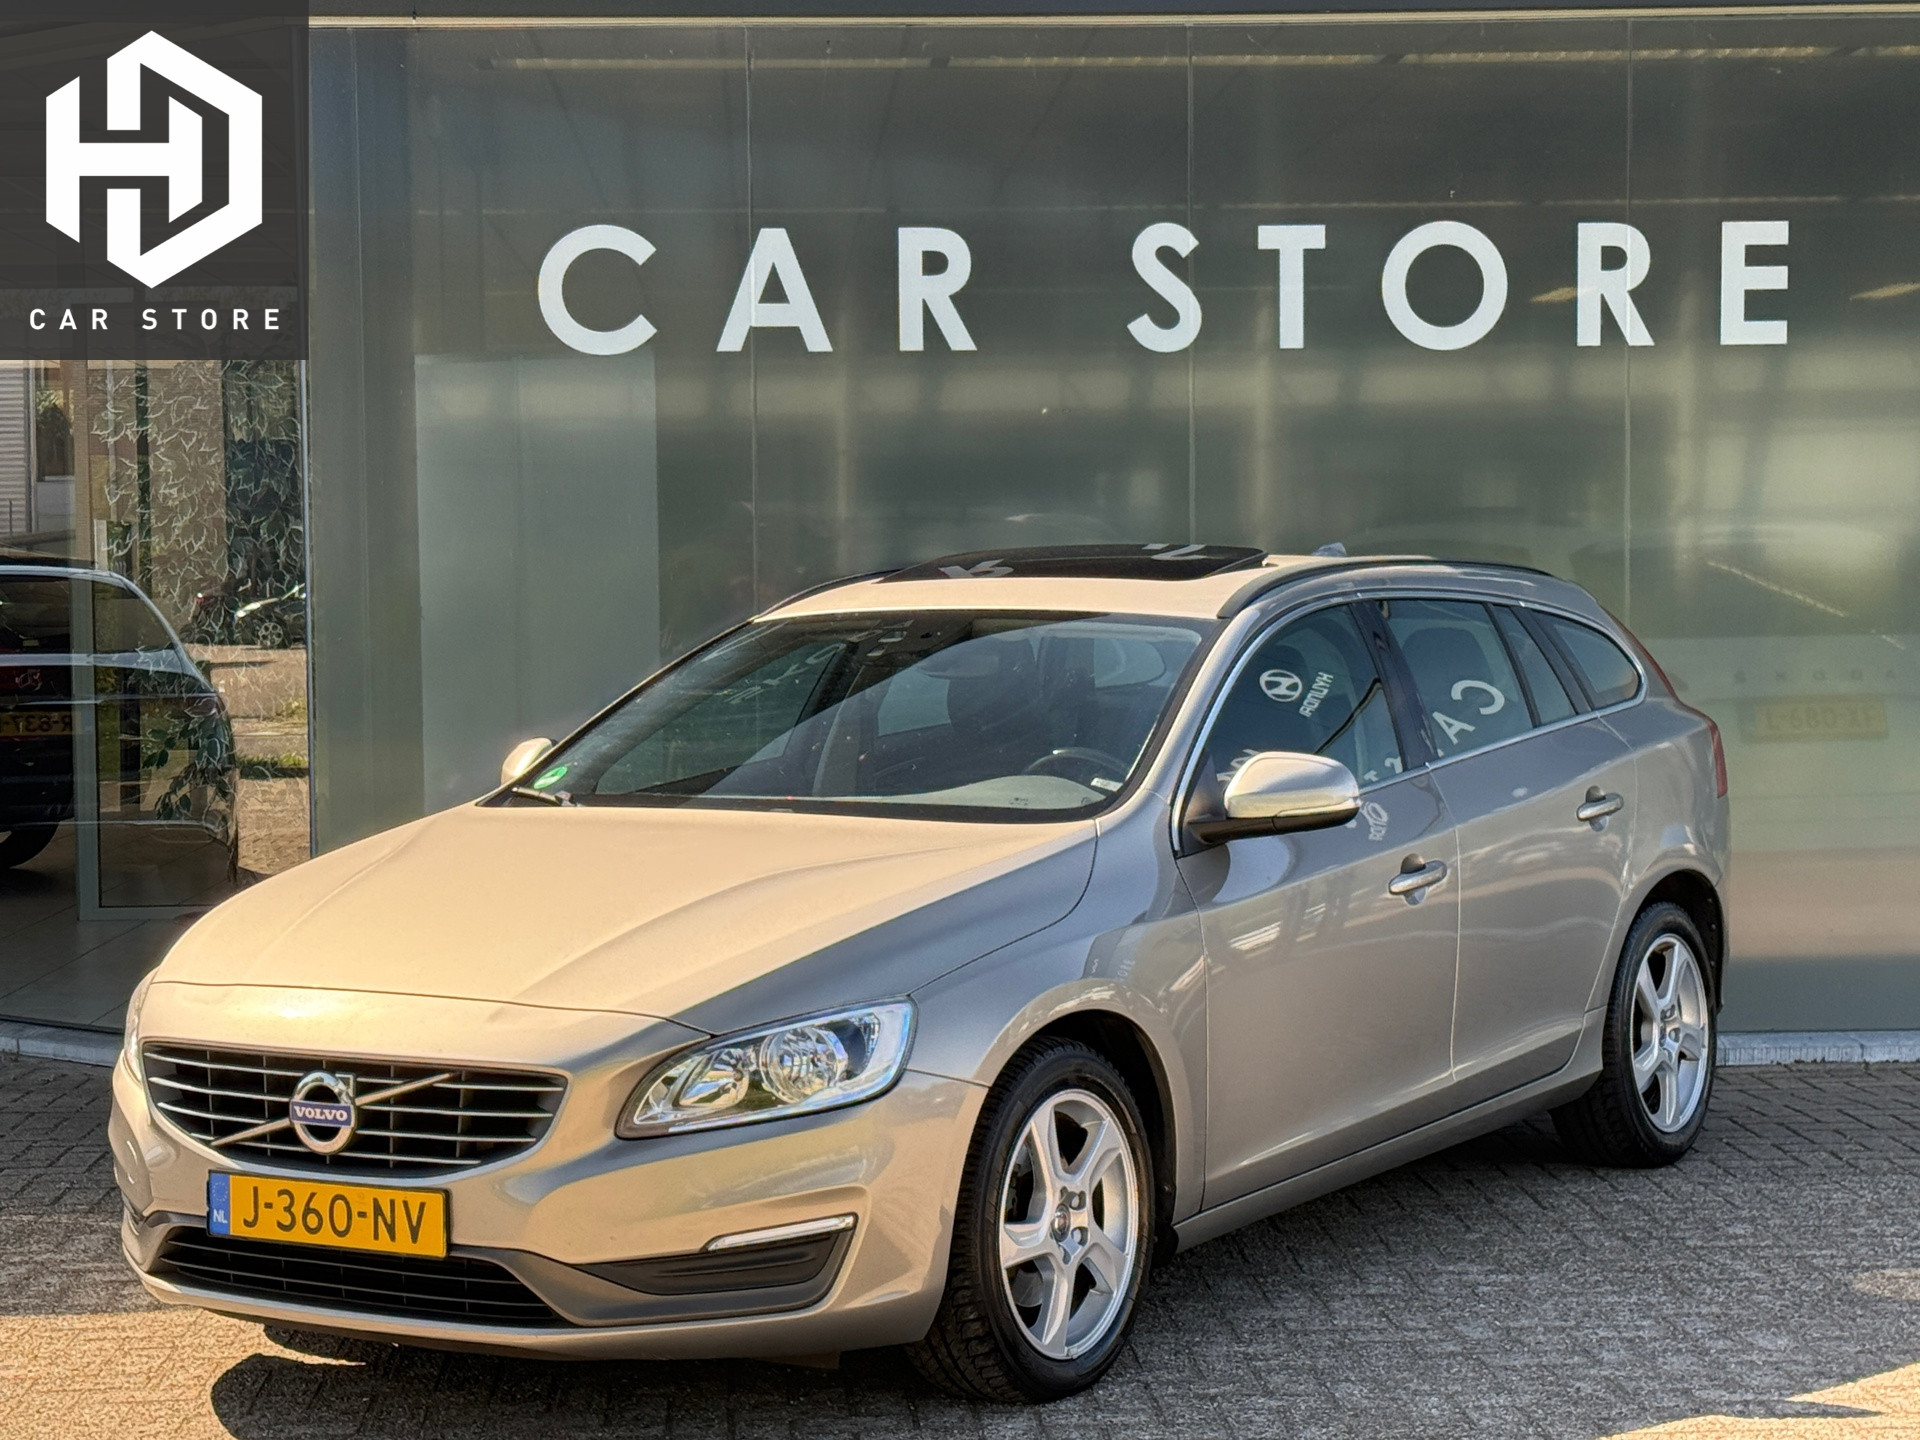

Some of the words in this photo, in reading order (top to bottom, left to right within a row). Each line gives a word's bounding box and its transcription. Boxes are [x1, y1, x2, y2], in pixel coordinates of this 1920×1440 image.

[538, 224, 978, 356] CAR
[1127, 220, 1789, 353] STORE
[293, 1106, 348, 1121] VOLVO
[213, 1209, 228, 1224] NL
[243, 1186, 426, 1244] J-360-NV
